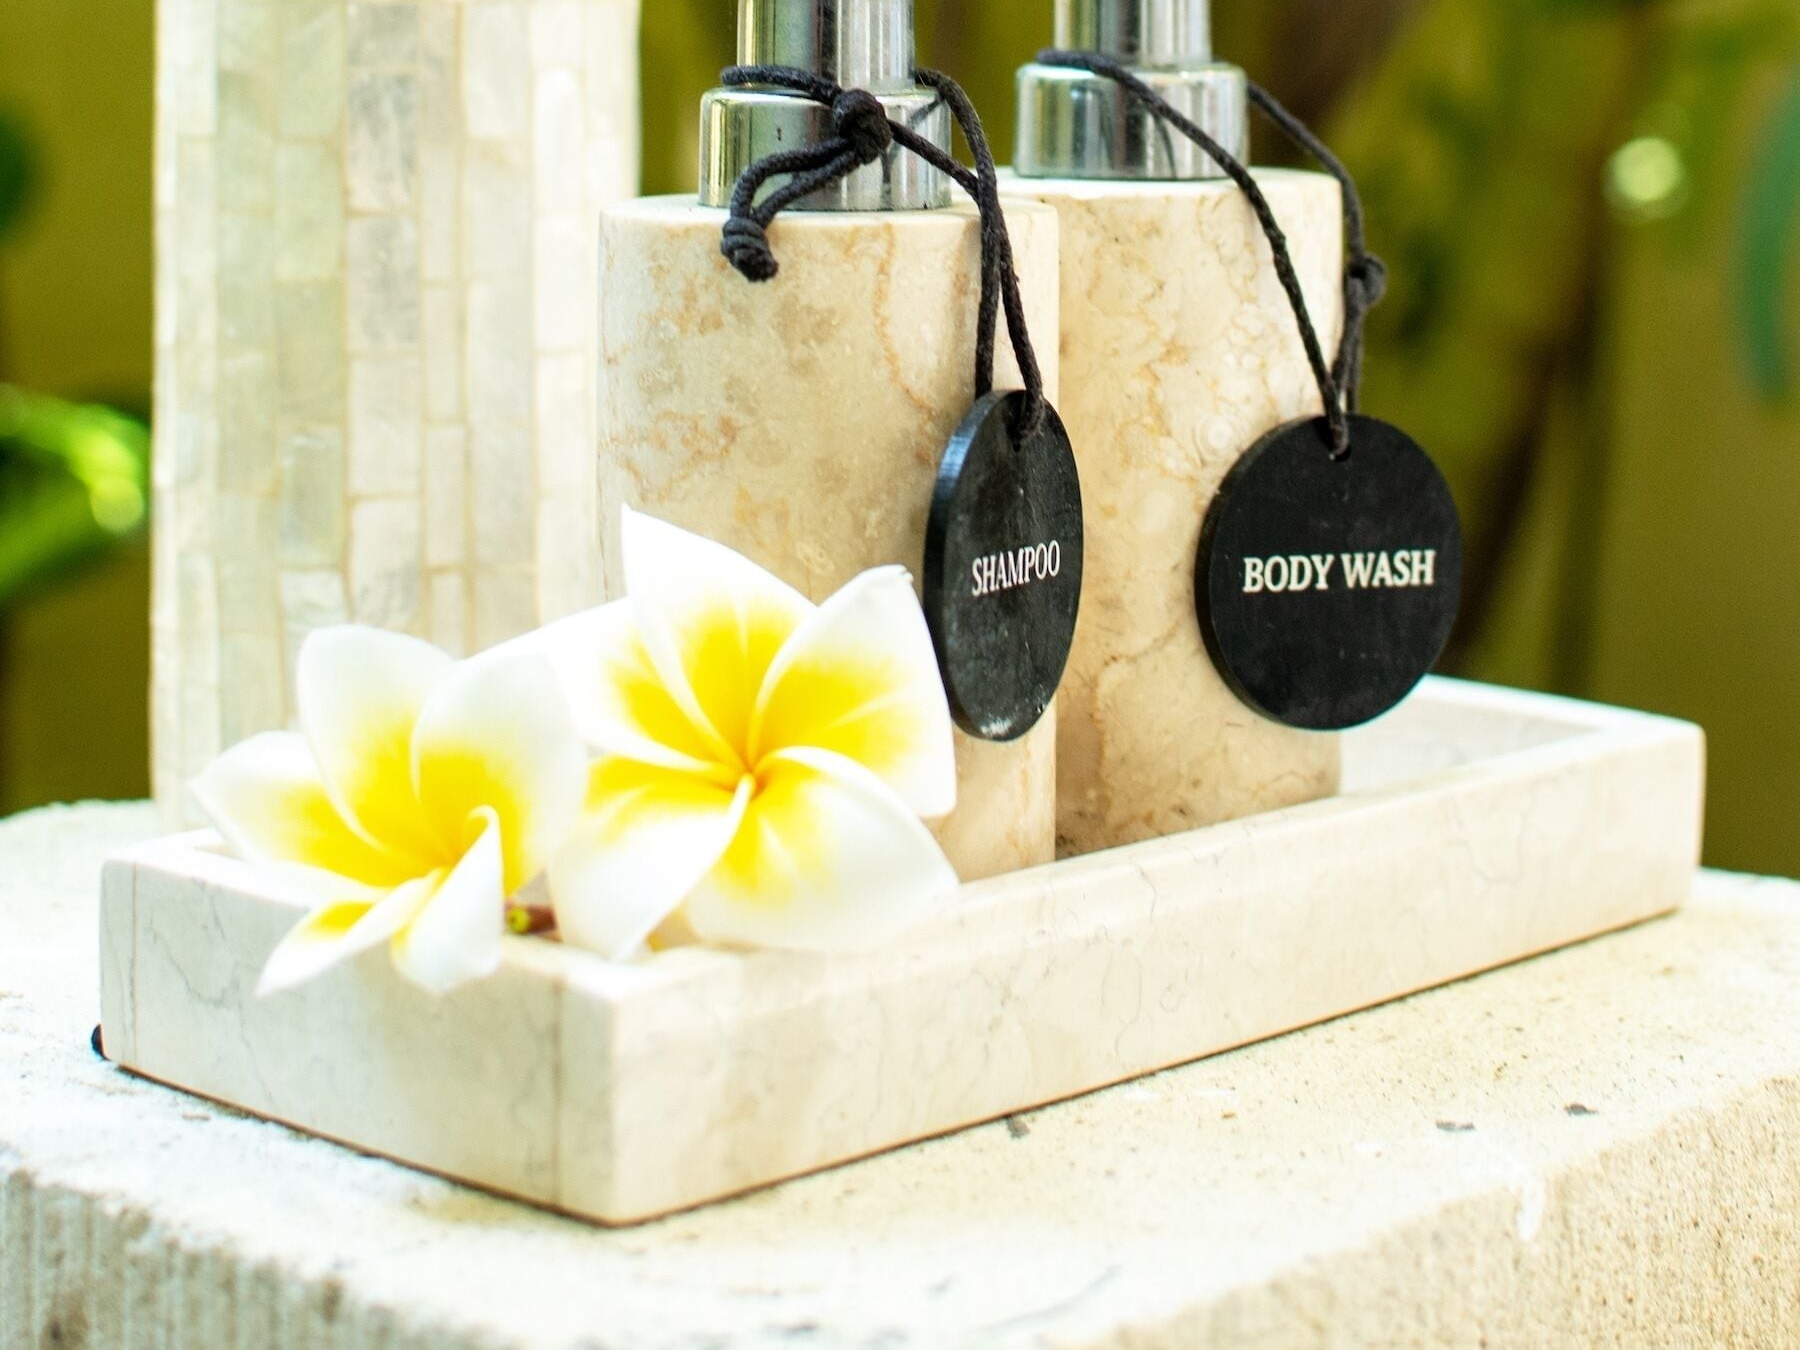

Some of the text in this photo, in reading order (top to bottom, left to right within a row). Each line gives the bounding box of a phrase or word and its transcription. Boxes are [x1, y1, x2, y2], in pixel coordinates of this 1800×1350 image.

[971, 539, 1061, 597] SHAMPOO
[1242, 549, 1436, 593] BODY WASH
